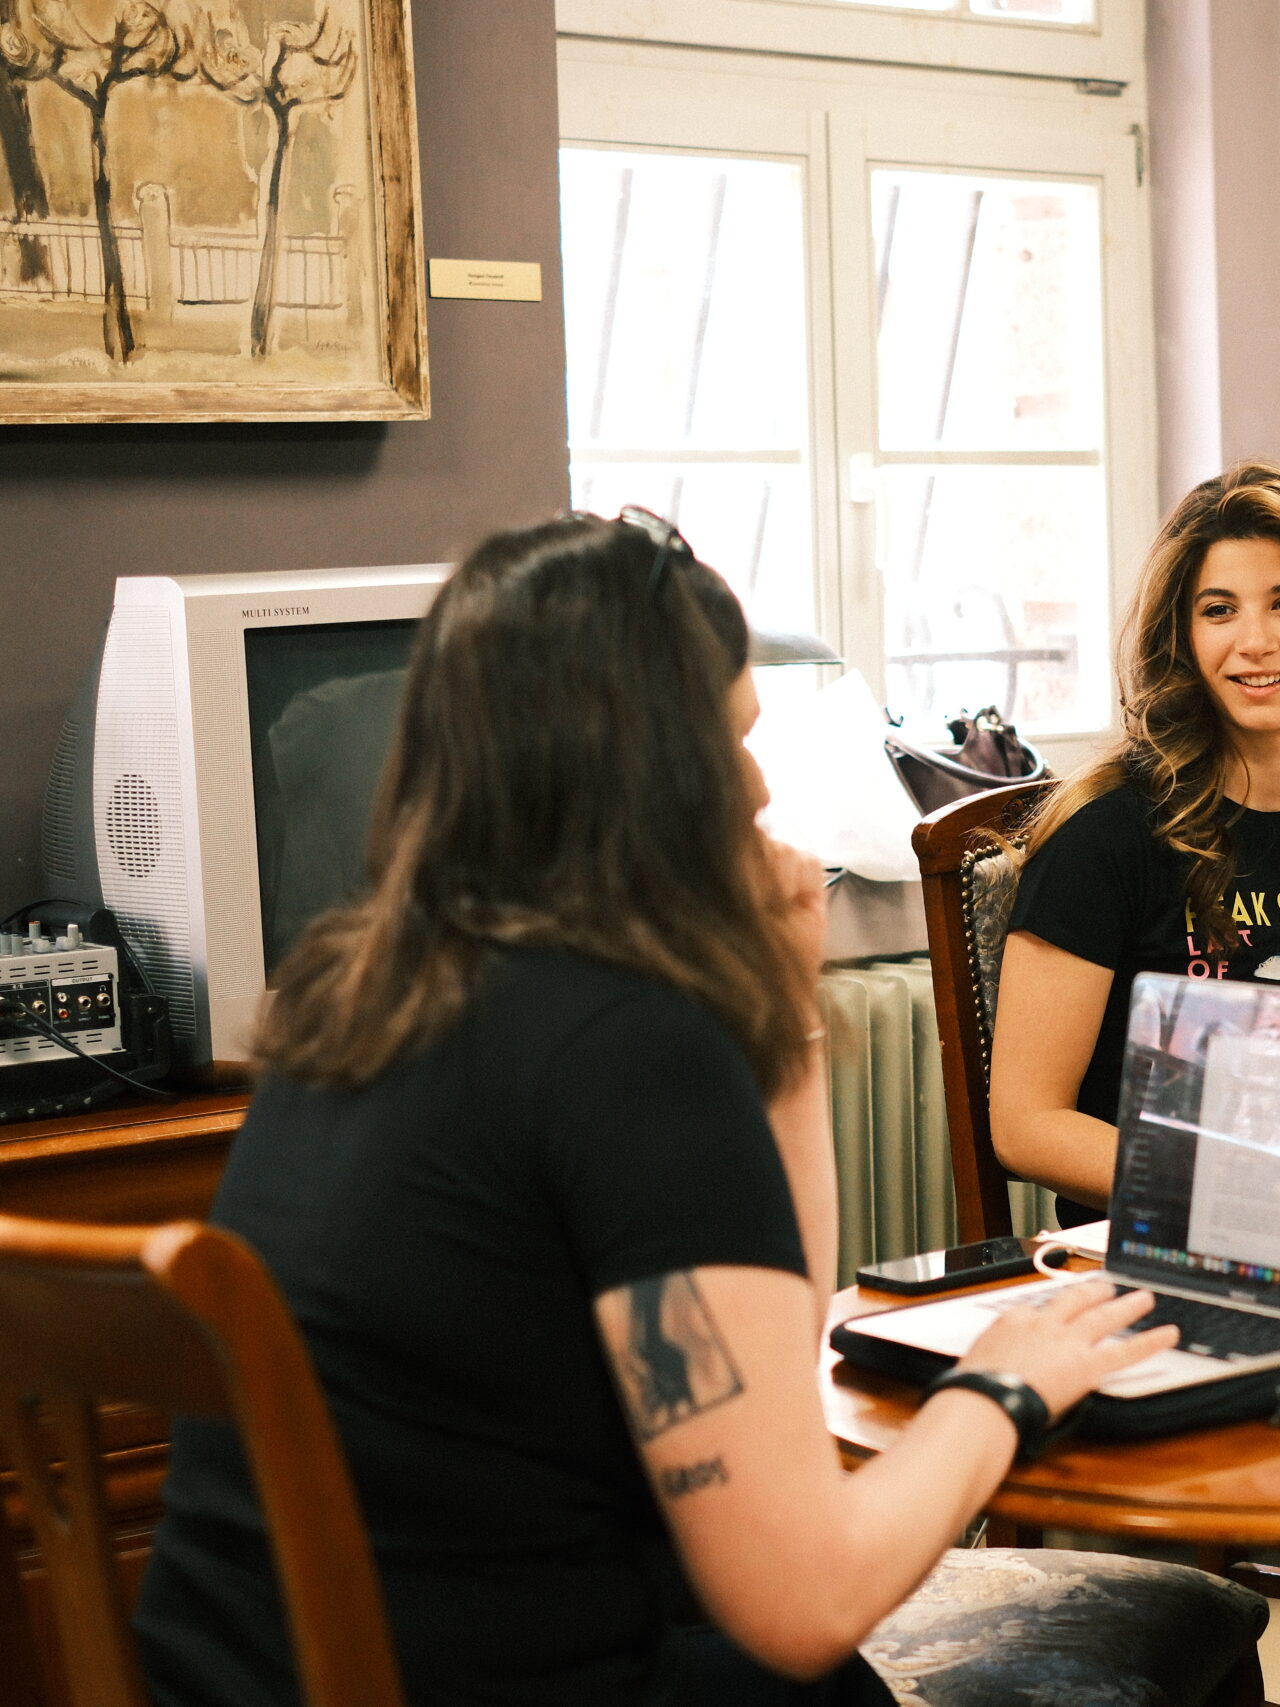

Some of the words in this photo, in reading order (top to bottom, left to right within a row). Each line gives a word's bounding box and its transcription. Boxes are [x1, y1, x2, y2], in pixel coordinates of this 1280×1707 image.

[242, 608, 271, 618] MULTI
[273, 606, 310, 617] SYSTEM
[1187, 959, 1229, 980] OF
